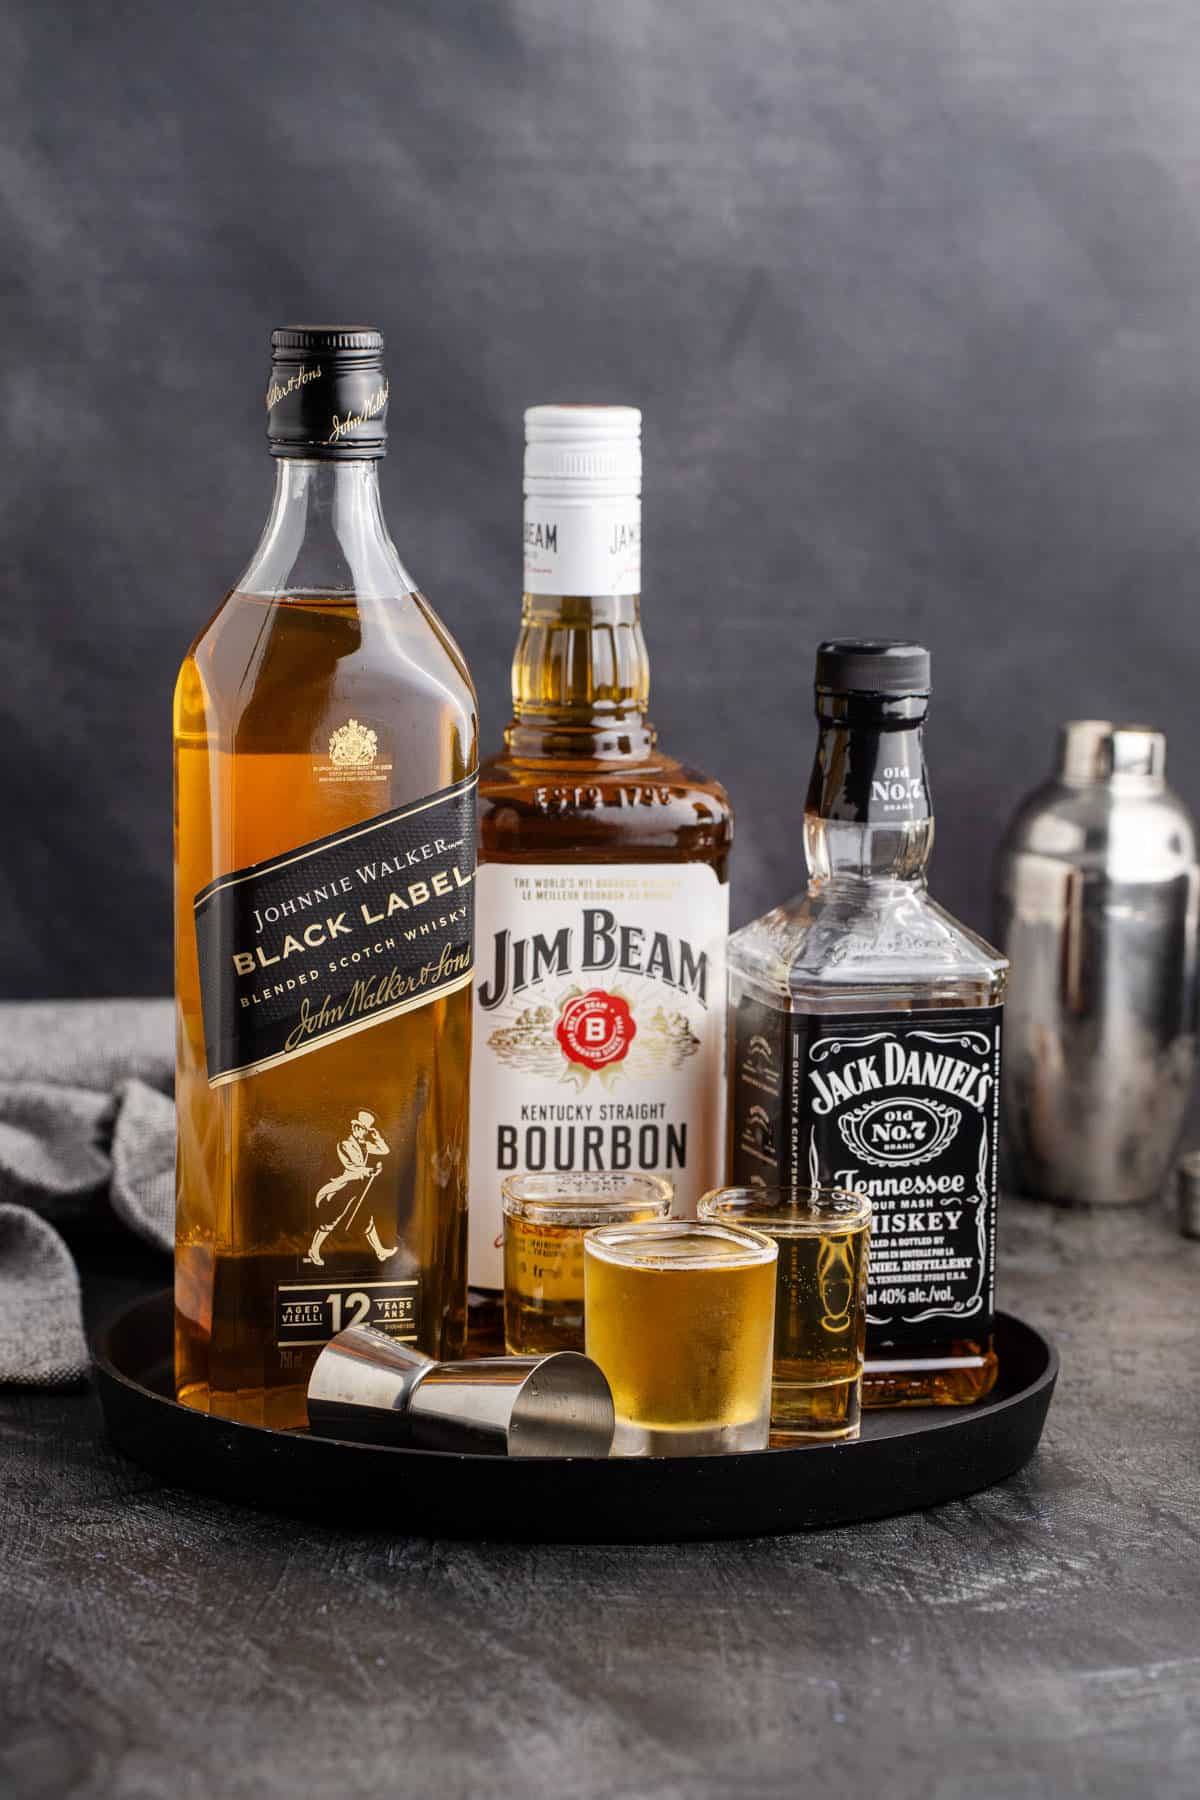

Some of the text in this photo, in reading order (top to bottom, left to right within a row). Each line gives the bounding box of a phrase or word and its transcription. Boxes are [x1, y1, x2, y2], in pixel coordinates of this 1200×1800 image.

[524, 521, 558, 554] EAM
[871, 779, 921, 801] No.7
[253, 839, 449, 933] JOHNNIE WALKER
[232, 866, 473, 976] BLACK LABEL
[240, 907, 468, 1008] BLENDED SCOTCH WHISKY
[478, 909, 709, 1011] JIM BEAM
[284, 994, 349, 1051] John
[348, 966, 417, 1017] Walker
[430, 942, 472, 984] Sons
[808, 1042, 993, 1115] JACK DANIEL'S
[521, 1103, 667, 1121] KENTUCKY STRAIGHT
[871, 1121, 927, 1142] No.7
[497, 1122, 688, 1171] BOURBON
[832, 1170, 966, 1201] Tennessee
[871, 1199, 934, 1210] OUR MASH
[898, 1236, 932, 1247] BOTTLED
[933, 1236, 945, 1245] BY
[902, 1257, 973, 1272] DISTILLERY
[879, 1288, 907, 1304] 40%
[908, 1285, 955, 1303] alc./vol.
[286, 1305, 320, 1314] AGED
[326, 1291, 371, 1333] 12
[376, 1301, 412, 1311] YEARS
[384, 1310, 405, 1318] ANS
[282, 1313, 323, 1322] VIEILLI
